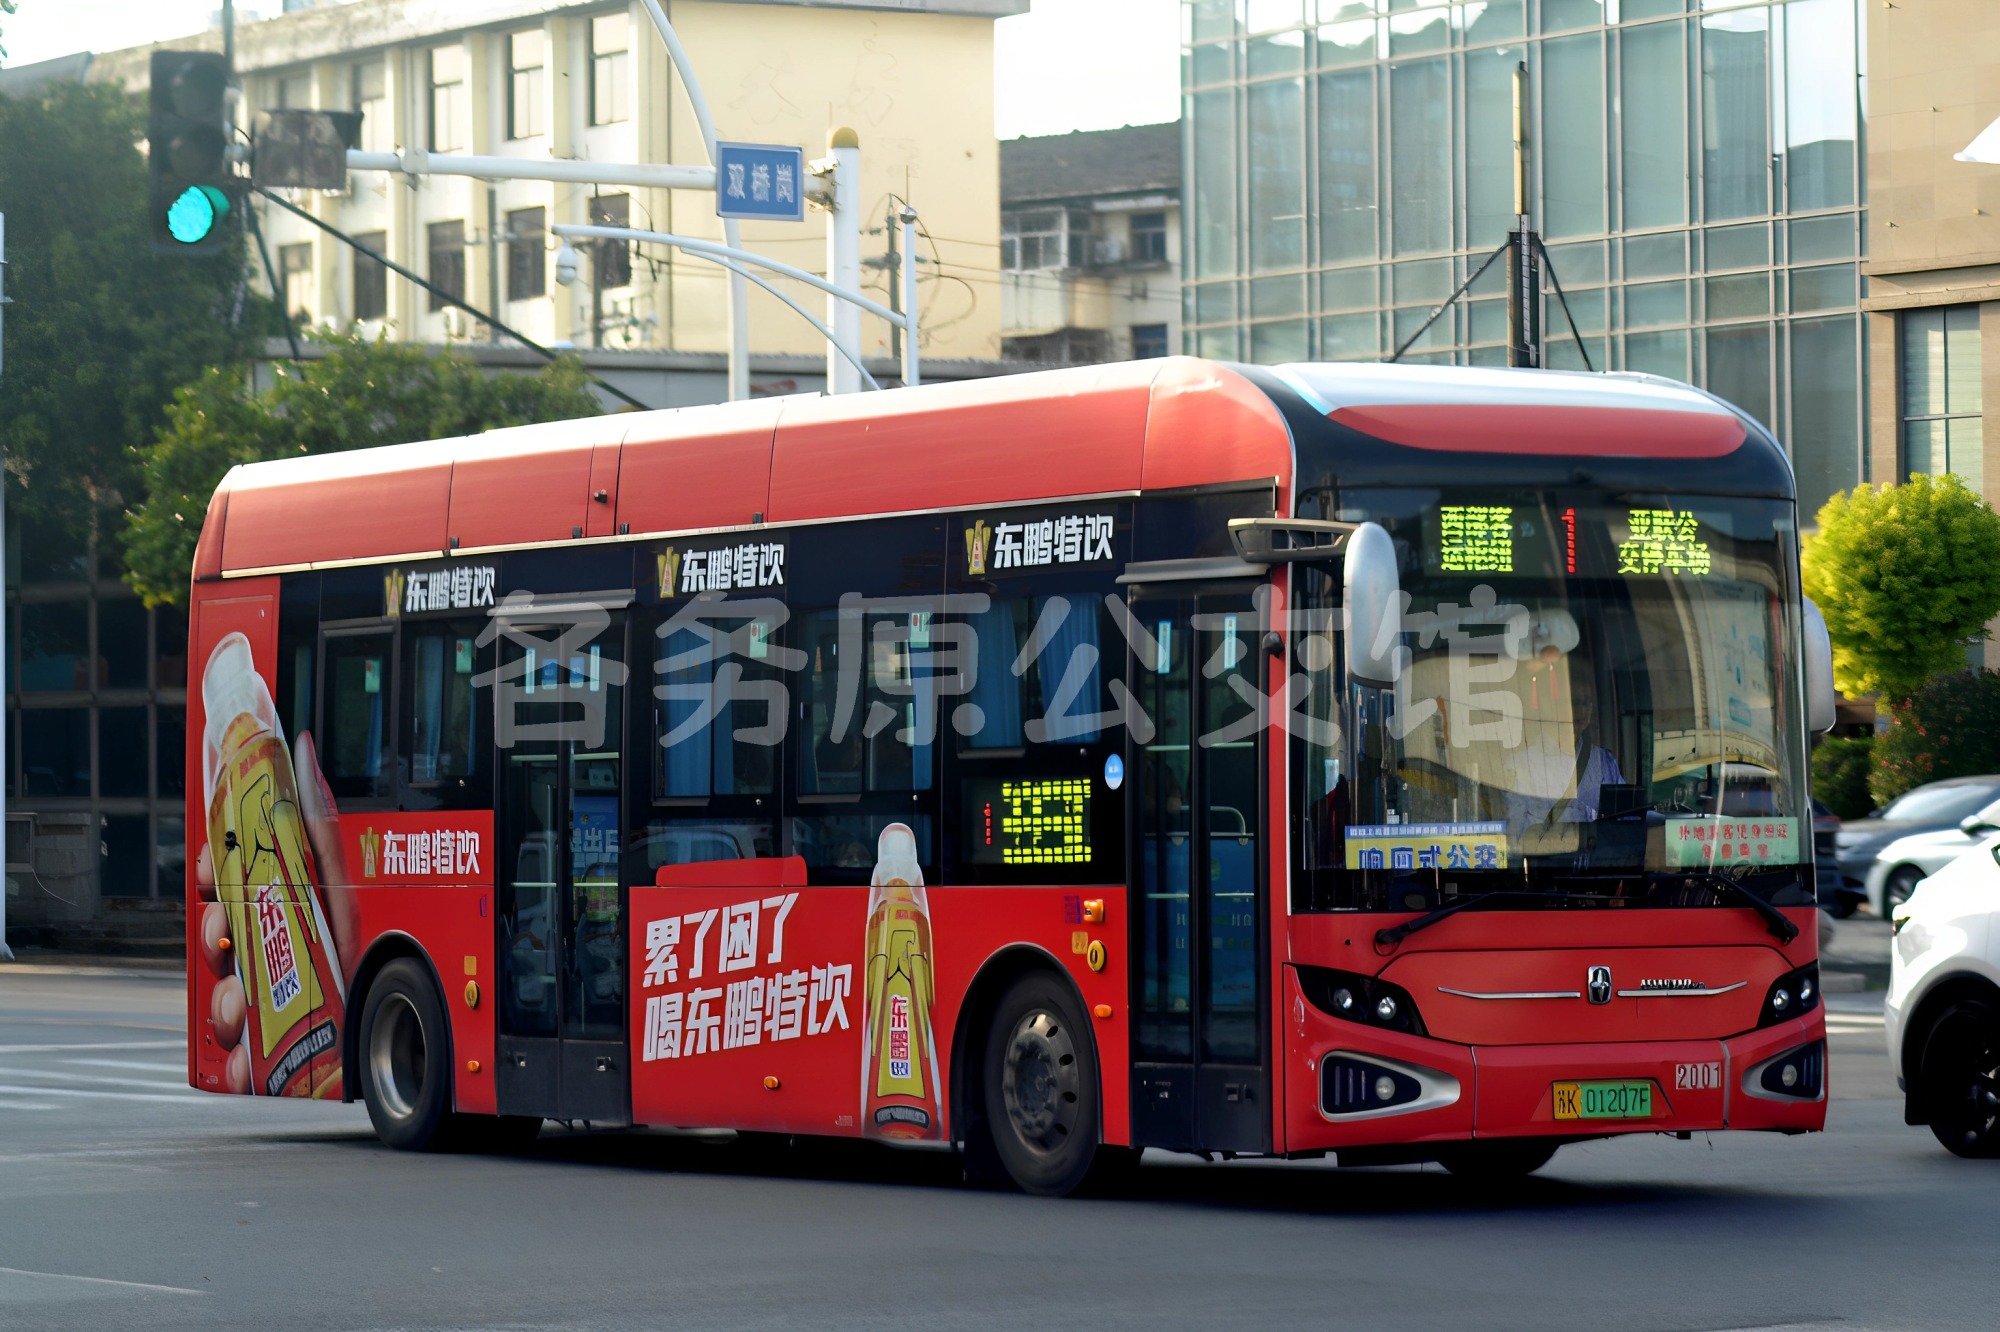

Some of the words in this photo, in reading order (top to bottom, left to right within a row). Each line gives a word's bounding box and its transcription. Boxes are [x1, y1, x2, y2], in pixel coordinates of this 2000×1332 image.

[994, 514, 1114, 568] 东鹏特饮
[1561, 508, 1575, 573] 1
[405, 565, 495, 612] 东鹏特饮
[681, 543, 784, 592] 东鹏特饮
[383, 829, 480, 875] 东鹏特饮
[642, 892, 800, 988] 累了困了
[642, 962, 853, 1062] 喝东鹏特饮
[1676, 1063, 1720, 1090] 2001
